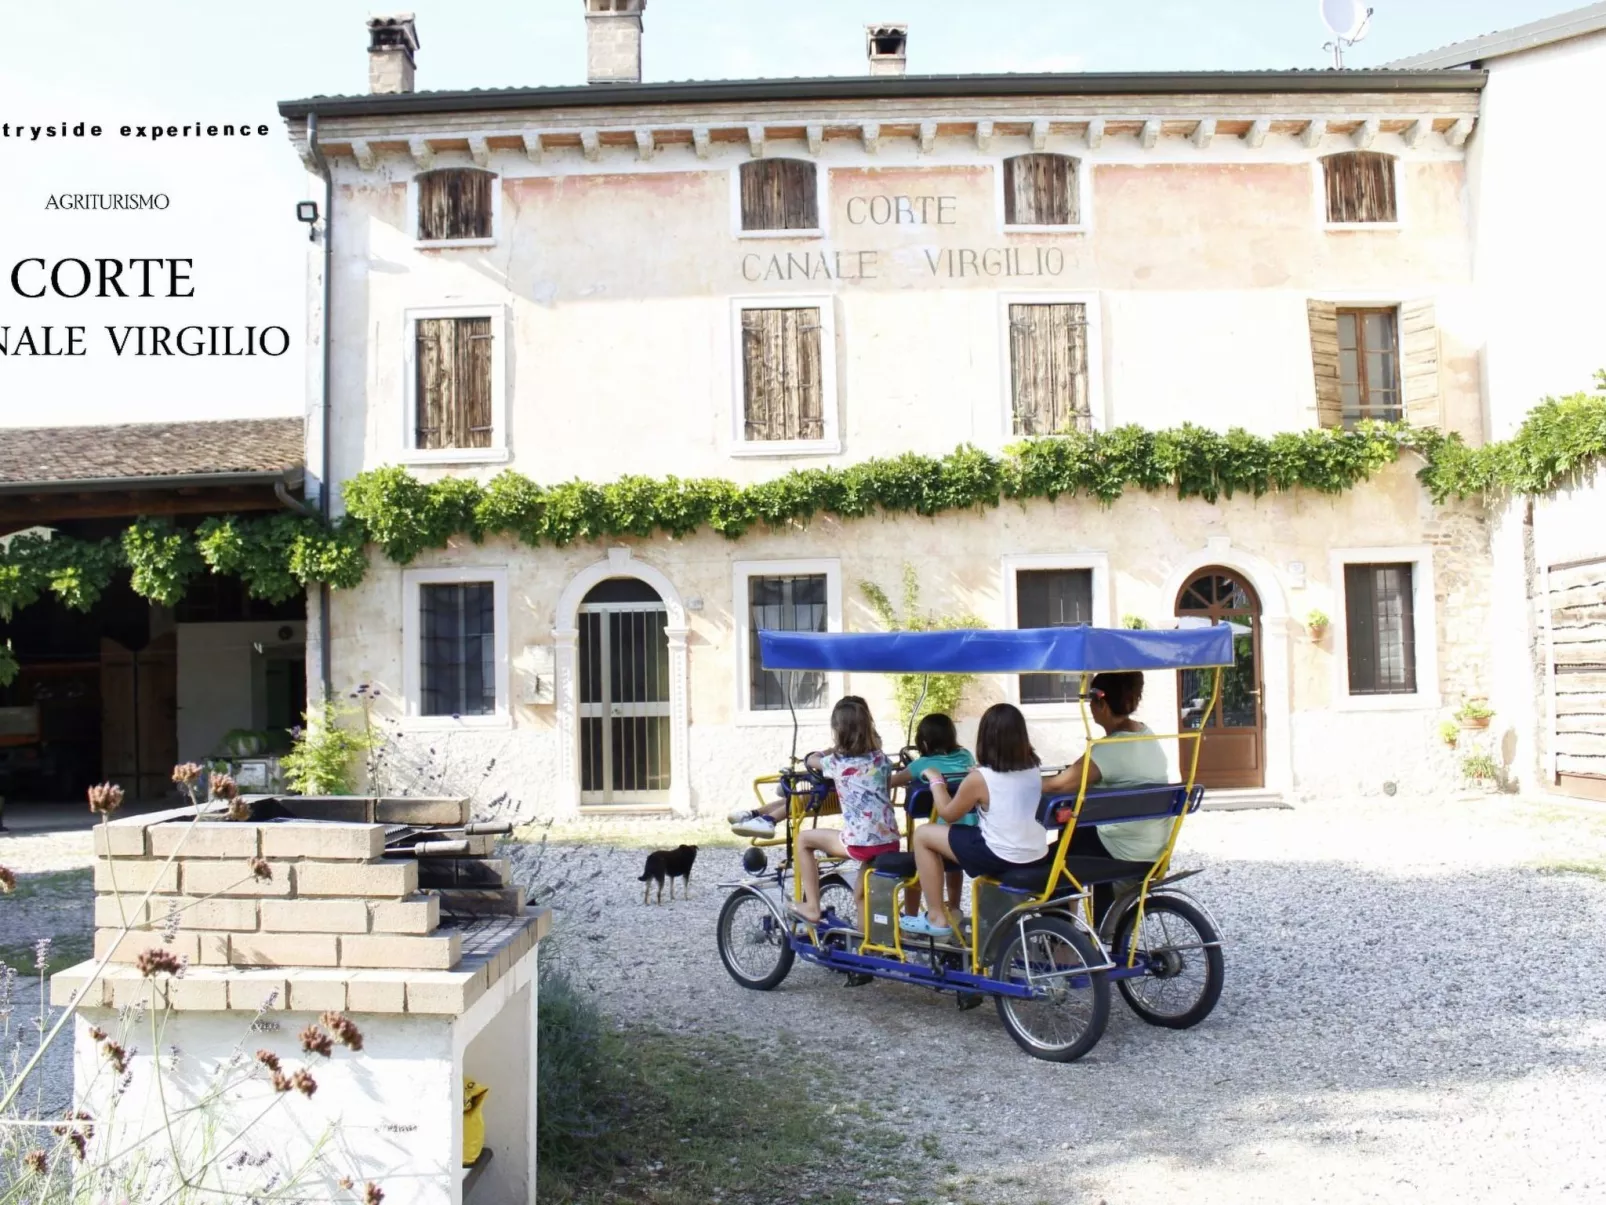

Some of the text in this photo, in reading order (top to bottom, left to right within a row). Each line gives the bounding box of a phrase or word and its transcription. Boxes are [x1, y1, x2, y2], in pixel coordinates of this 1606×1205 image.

[845, 195, 957, 225] CORTE
[741, 247, 1065, 281] CANALE VIRGILIO
